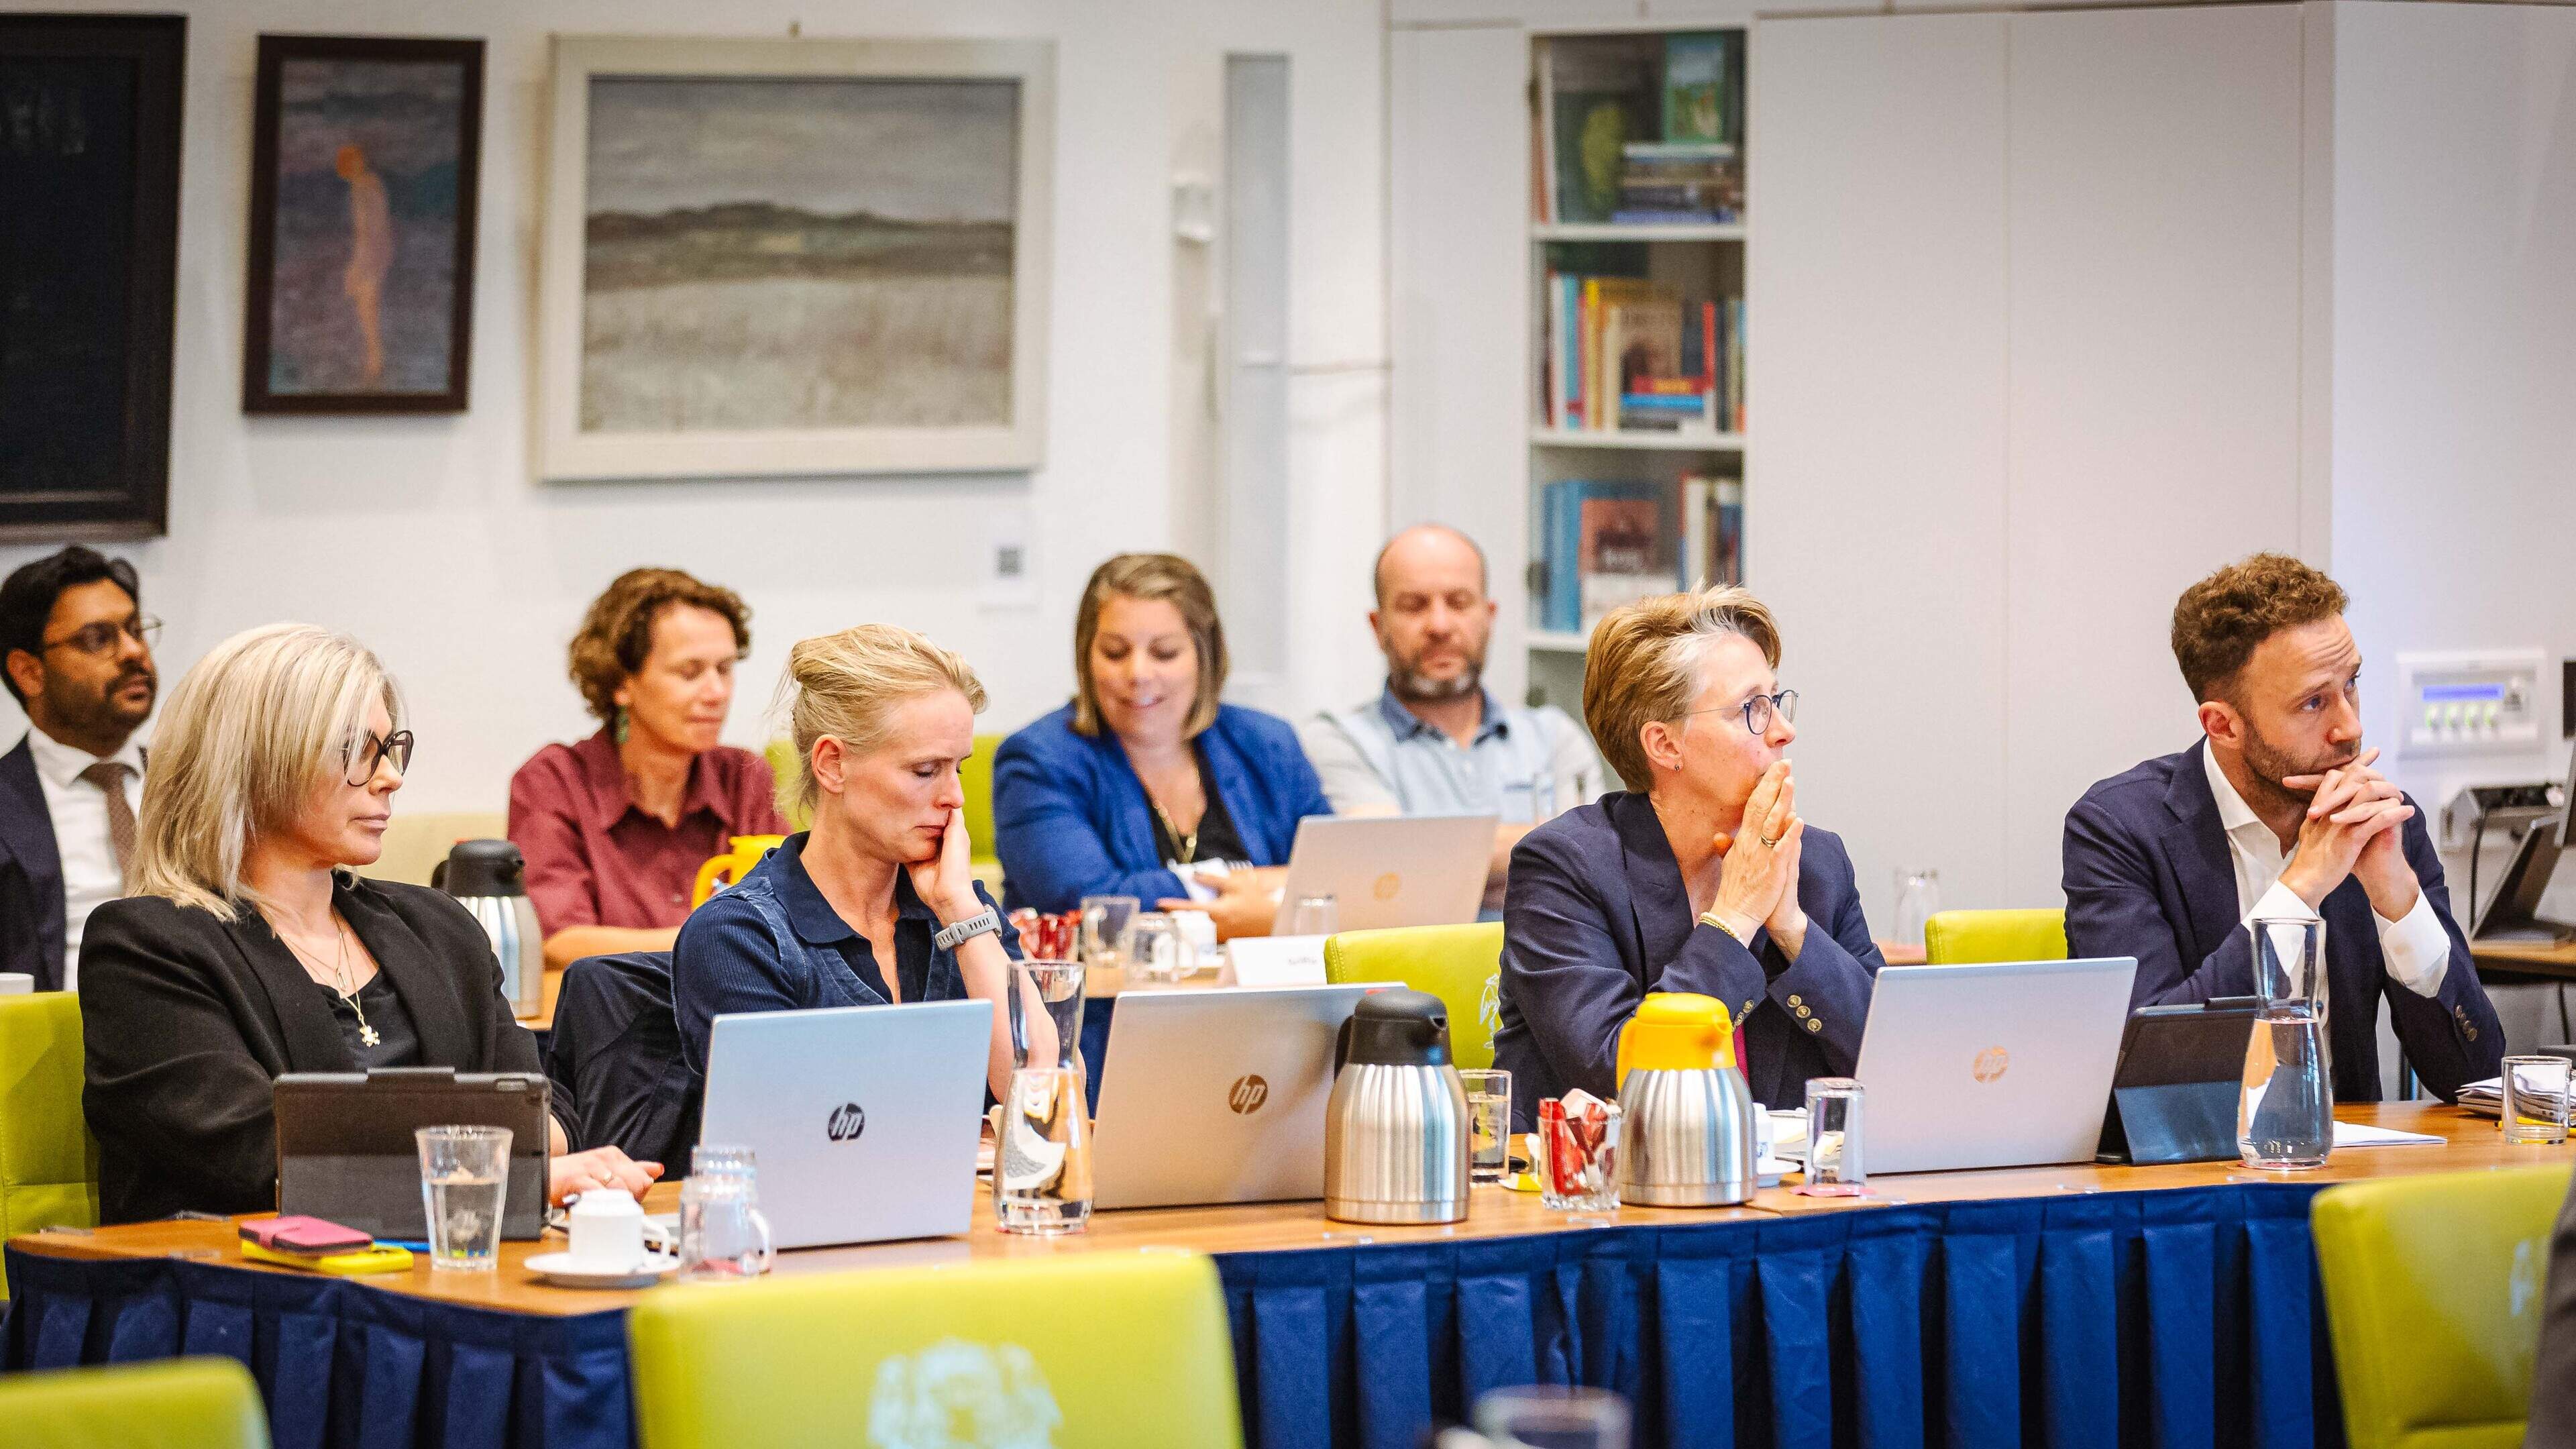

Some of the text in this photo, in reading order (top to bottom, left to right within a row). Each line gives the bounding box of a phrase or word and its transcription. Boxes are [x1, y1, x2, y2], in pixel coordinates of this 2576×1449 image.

[1974, 1045, 2008, 1083] hp
[1230, 1075, 1267, 1114] hp
[829, 1104, 864, 1141] hp
